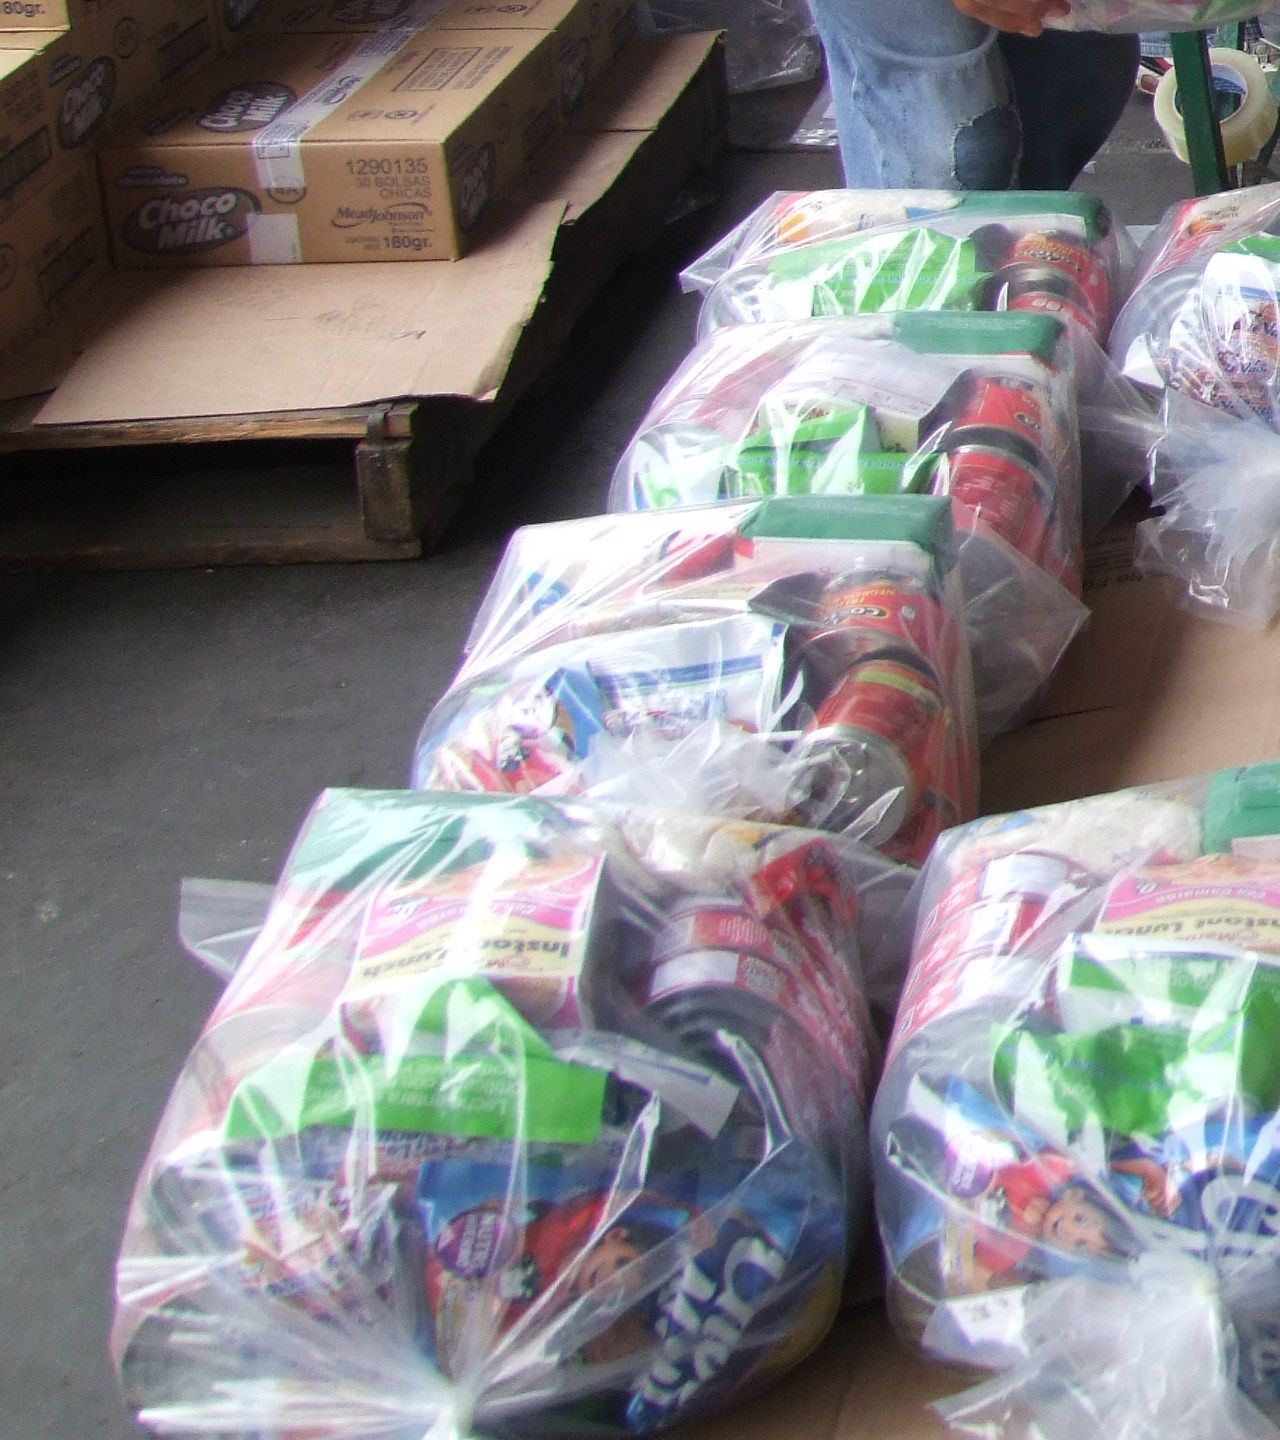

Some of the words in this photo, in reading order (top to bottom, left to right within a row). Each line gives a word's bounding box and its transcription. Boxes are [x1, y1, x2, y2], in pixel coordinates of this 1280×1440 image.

[346, 160, 427, 175] 1290135
[375, 176, 430, 189] BOLSAS
[381, 188, 431, 199] CHICAS
[138, 193, 237, 228] Choco
[157, 219, 226, 251] Milk
[384, 237, 432, 252] 180gr.
